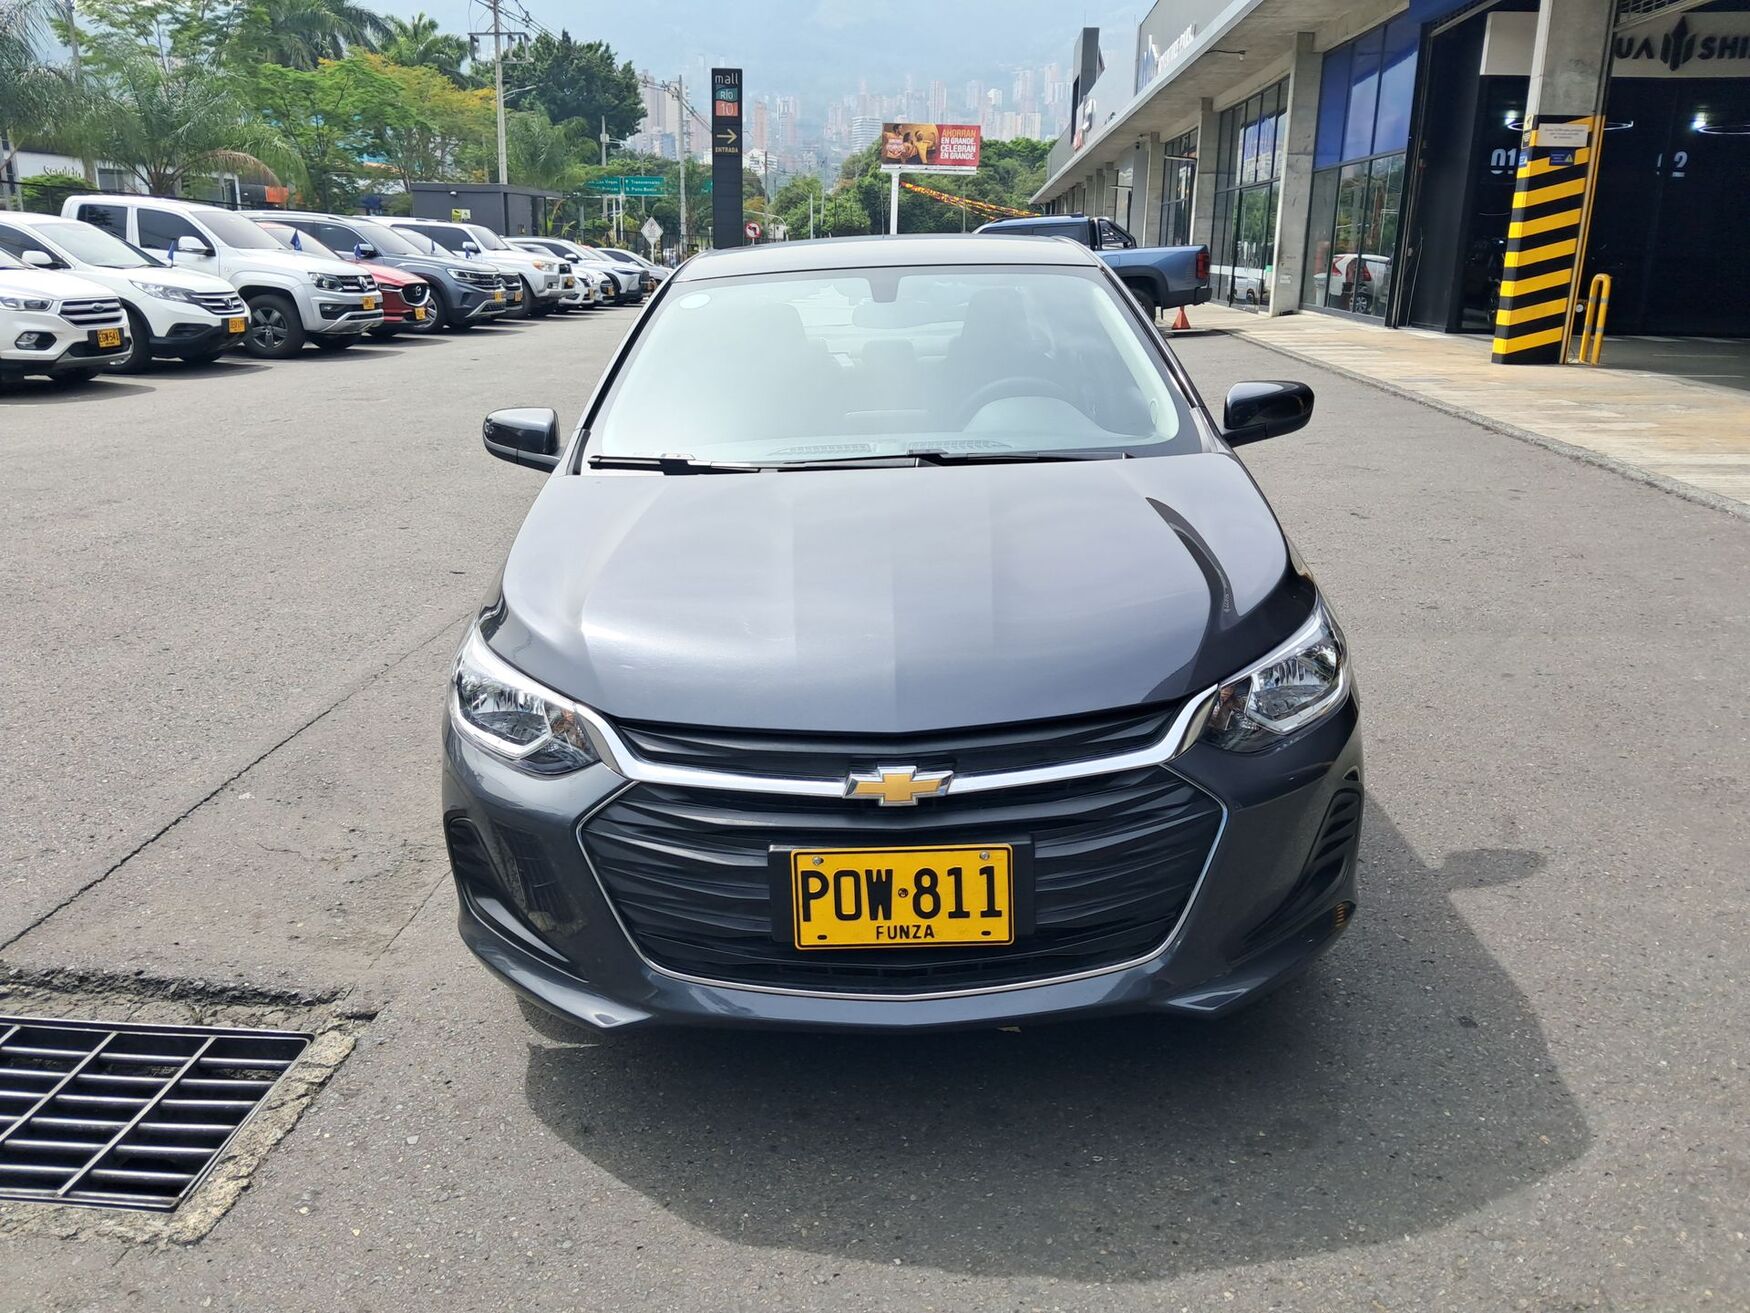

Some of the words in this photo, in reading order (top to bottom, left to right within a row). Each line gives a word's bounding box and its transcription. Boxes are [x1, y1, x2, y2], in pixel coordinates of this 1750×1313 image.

[1697, 35, 1750, 60] SHI
[715, 72, 738, 84] mall
[721, 103, 734, 116] 10
[943, 129, 976, 137] AHORRAN
[940, 144, 976, 152] CELEBRAN
[1490, 148, 1517, 175] 01
[800, 869, 893, 922] POW
[912, 865, 1003, 919] 811
[875, 924, 935, 940] FUNZA
